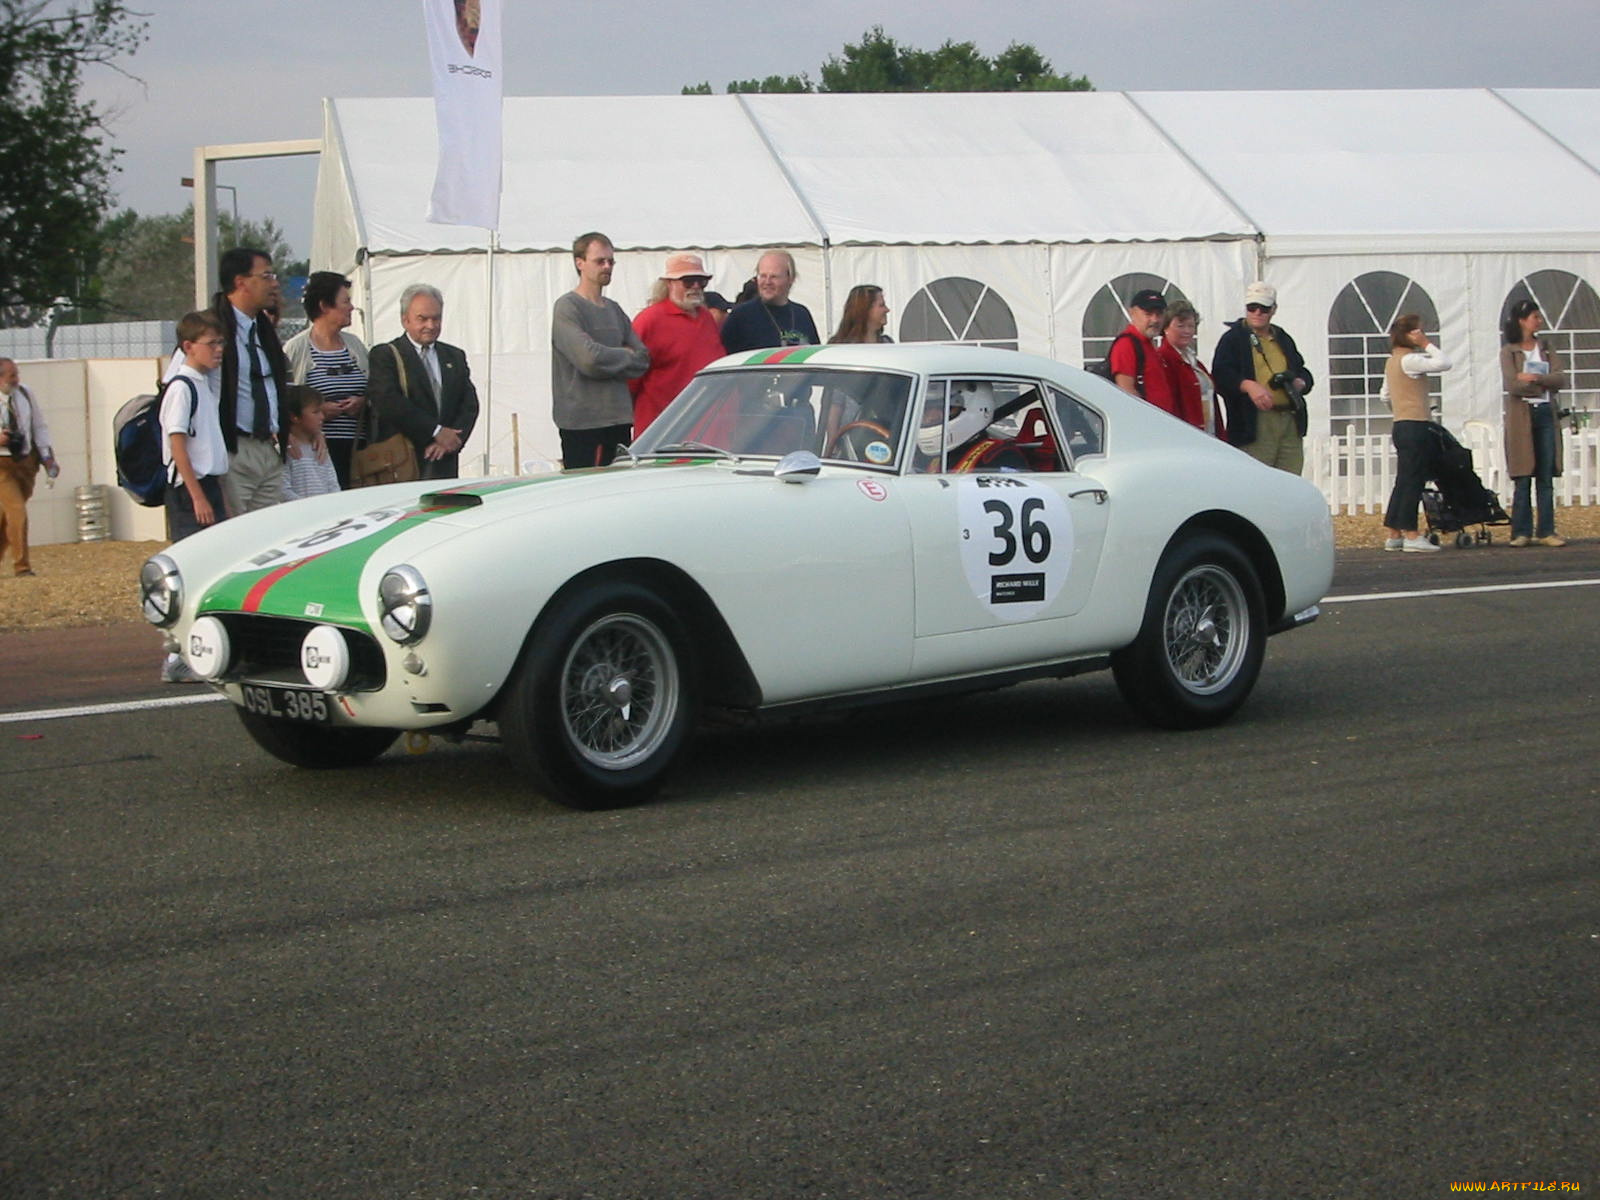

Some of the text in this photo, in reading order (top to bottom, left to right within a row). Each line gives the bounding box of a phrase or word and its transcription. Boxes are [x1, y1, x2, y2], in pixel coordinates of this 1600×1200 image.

[862, 481, 883, 496] E
[962, 528, 971, 540] 3
[983, 497, 1051, 567] 36
[284, 690, 328, 721] 385
